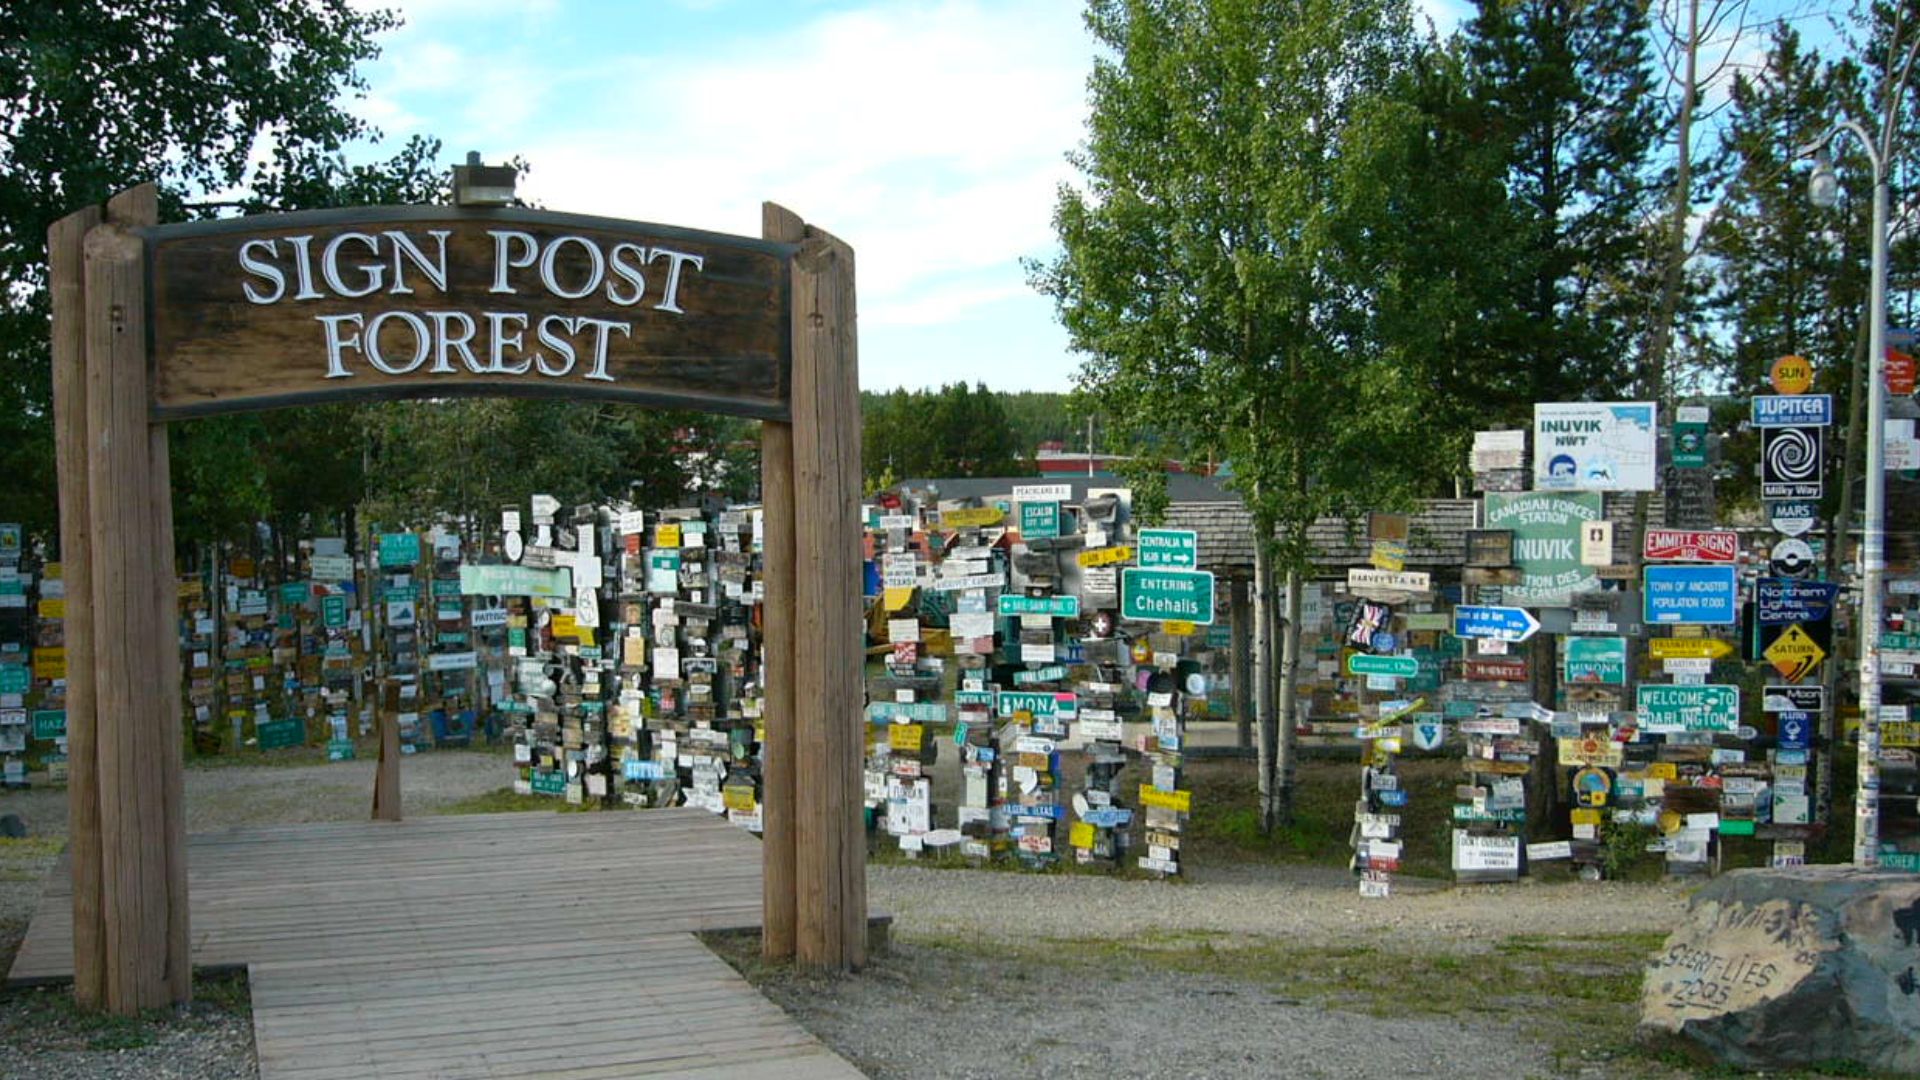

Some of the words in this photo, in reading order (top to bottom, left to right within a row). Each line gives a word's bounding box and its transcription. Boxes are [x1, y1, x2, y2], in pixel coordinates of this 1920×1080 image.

[238, 230, 452, 305] SIGN
[488, 230, 704, 314] POST
[315, 310, 632, 382] FOREST
[1778, 367, 1805, 379] SUN
[1757, 398, 1824, 415] JUPITER
[1540, 419, 1602, 433] INUVIK
[1555, 435, 1589, 447] NWT
[1765, 486, 1793, 496] Milky
[1794, 486, 1819, 496] Way
[1490, 498, 1549, 522] CANADIAN
[1552, 499, 1597, 521] FORCES
[1775, 505, 1810, 518] MARS
[1520, 512, 1569, 526] STATION
[1513, 538, 1575, 560] INUVIK
[1697, 534, 1734, 555] SIGNS
[1141, 578, 1195, 592] ENTERING
[1649, 581, 1673, 592] TOWN
[1675, 581, 1686, 592] OF
[1759, 587, 1828, 597] Northern
[1136, 595, 1199, 615] Chehalis
[1652, 597, 1700, 608] POPULATION
[1759, 599, 1804, 611] Lights
[1759, 609, 1811, 620] Centre
[1773, 645, 1816, 654] SATURN
[1642, 691, 1705, 706] WELCOME
[1718, 693, 1735, 706] TO
[1786, 689, 1822, 698] Moon
[1646, 711, 1729, 728] DARLINGTON
